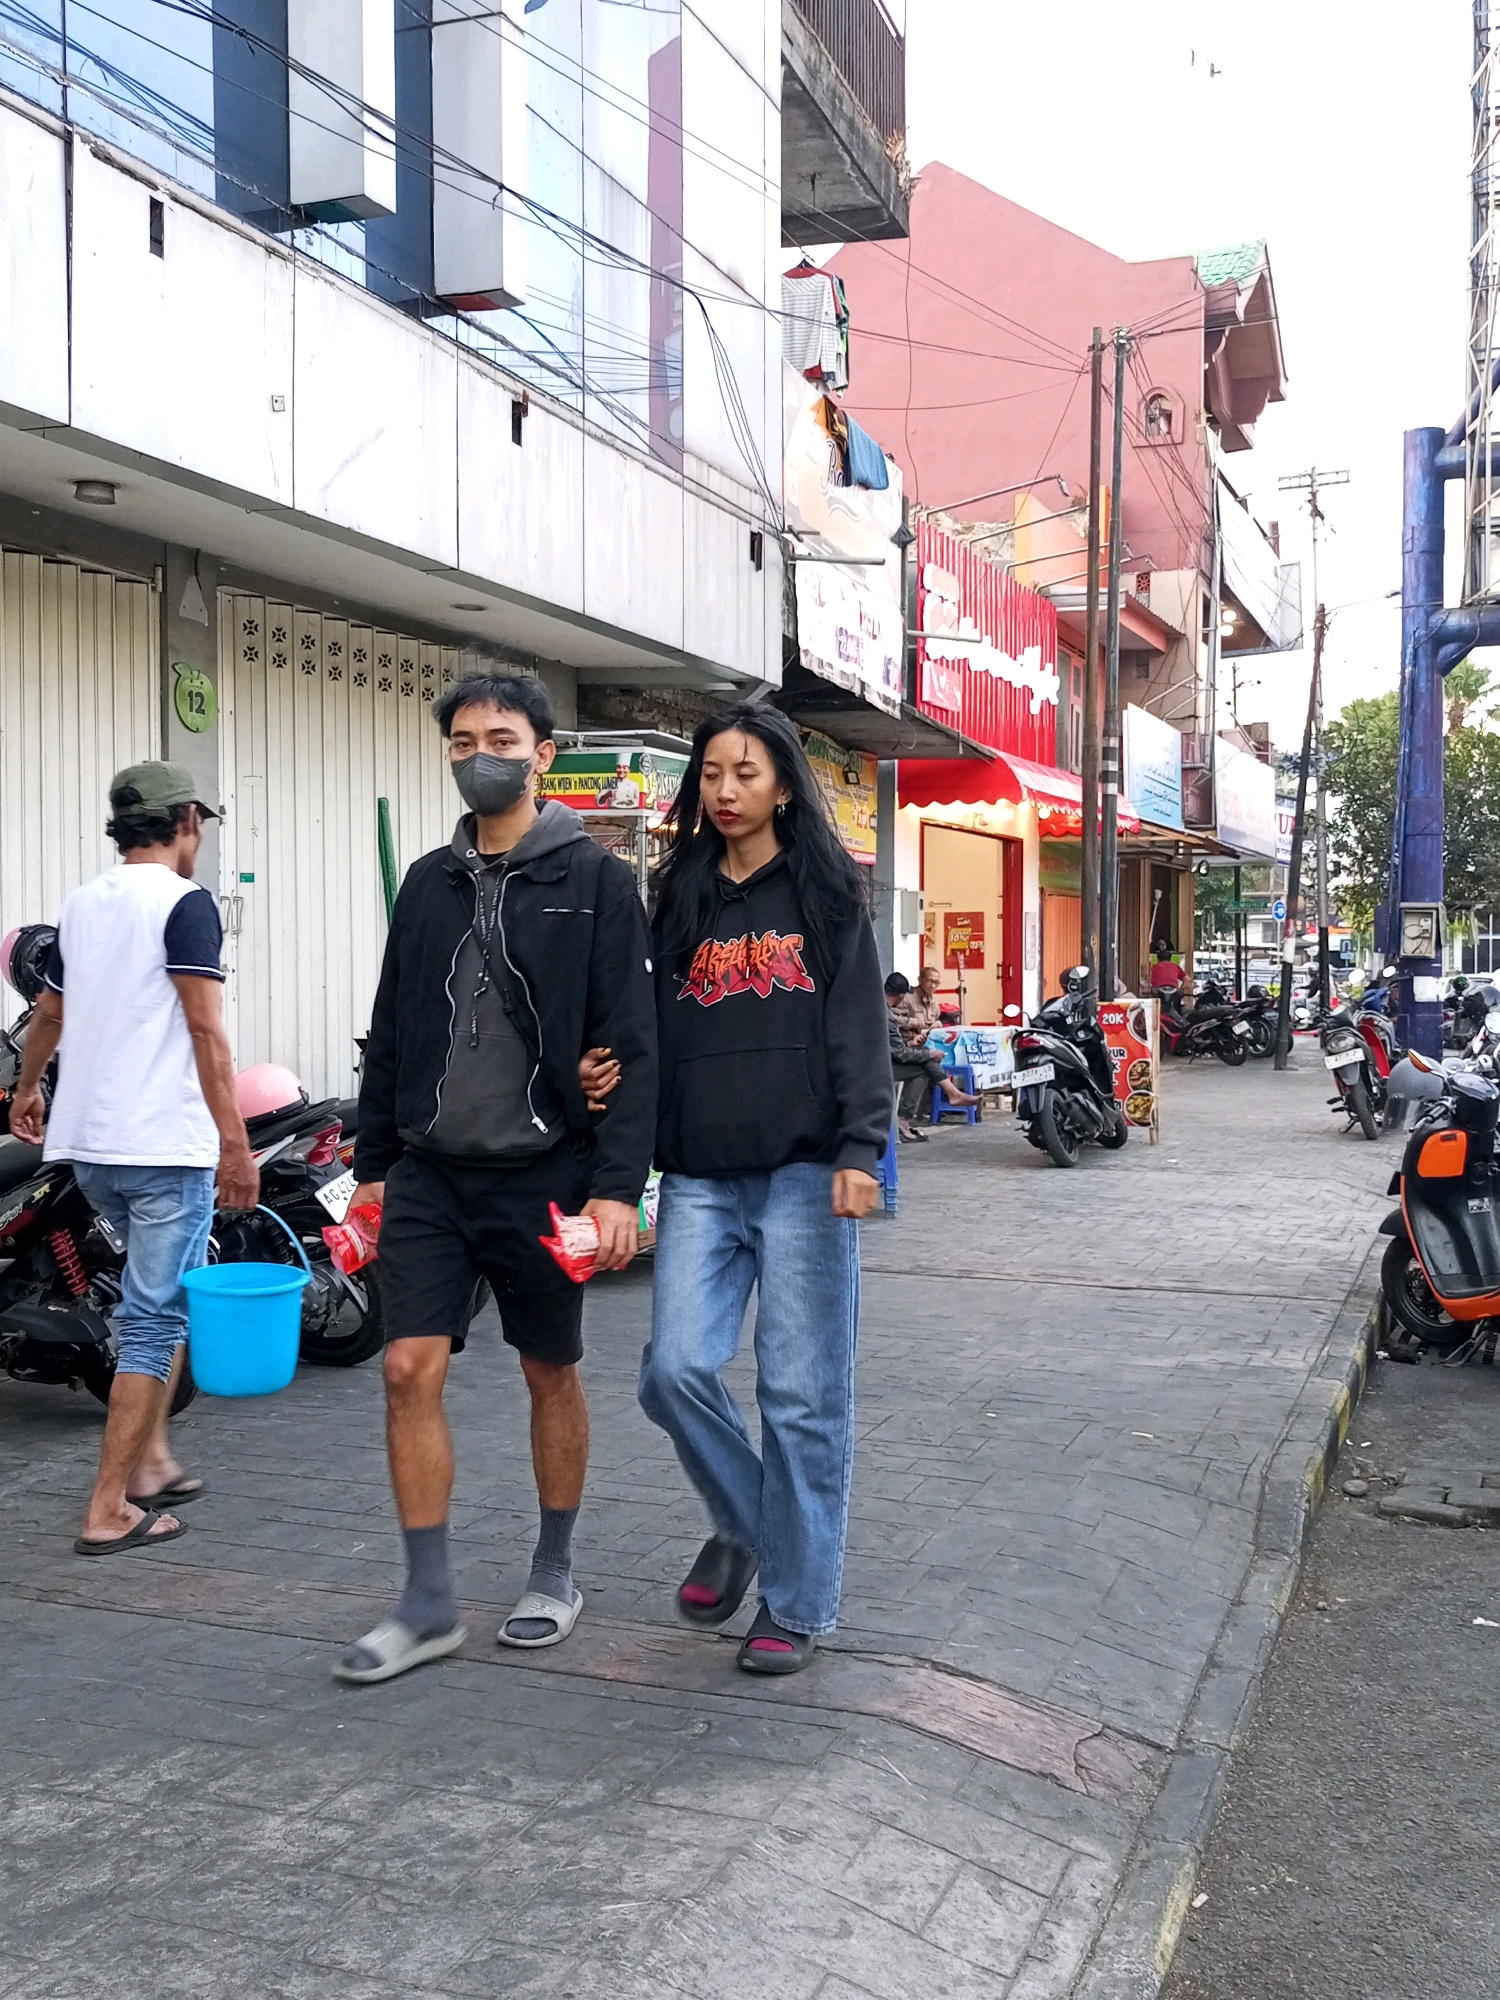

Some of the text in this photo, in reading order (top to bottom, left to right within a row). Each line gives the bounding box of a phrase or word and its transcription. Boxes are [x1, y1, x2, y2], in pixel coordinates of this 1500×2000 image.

[188, 690, 206, 715] 12
[1102, 1013, 1124, 1025] 20K
[323, 1188, 341, 1205] AG
